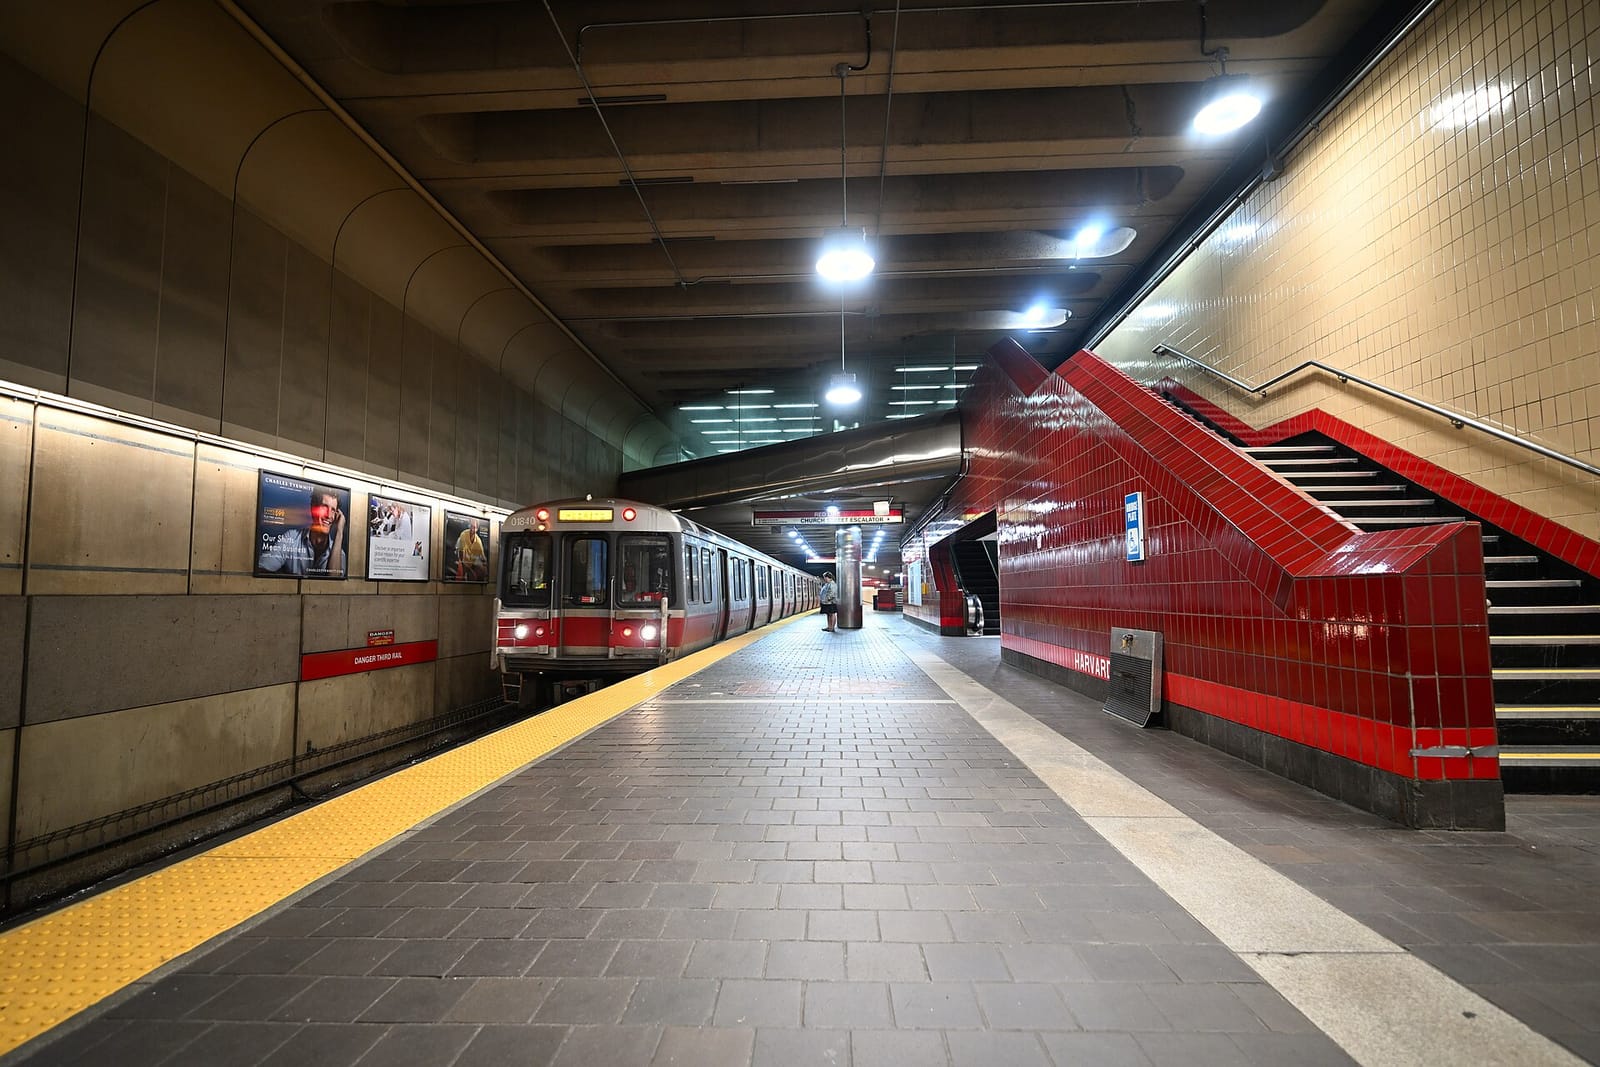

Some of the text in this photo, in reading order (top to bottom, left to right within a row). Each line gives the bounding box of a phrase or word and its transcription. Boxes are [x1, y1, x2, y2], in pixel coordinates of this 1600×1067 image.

[264, 477, 288, 487] CHARLES
[511, 516, 536, 526] 01840
[1127, 511, 1137, 522] PLATE
[262, 533, 276, 542] Our
[262, 542, 281, 551] Mean
[354, 655, 377, 665] DANGER
[376, 653, 391, 661] THIRD
